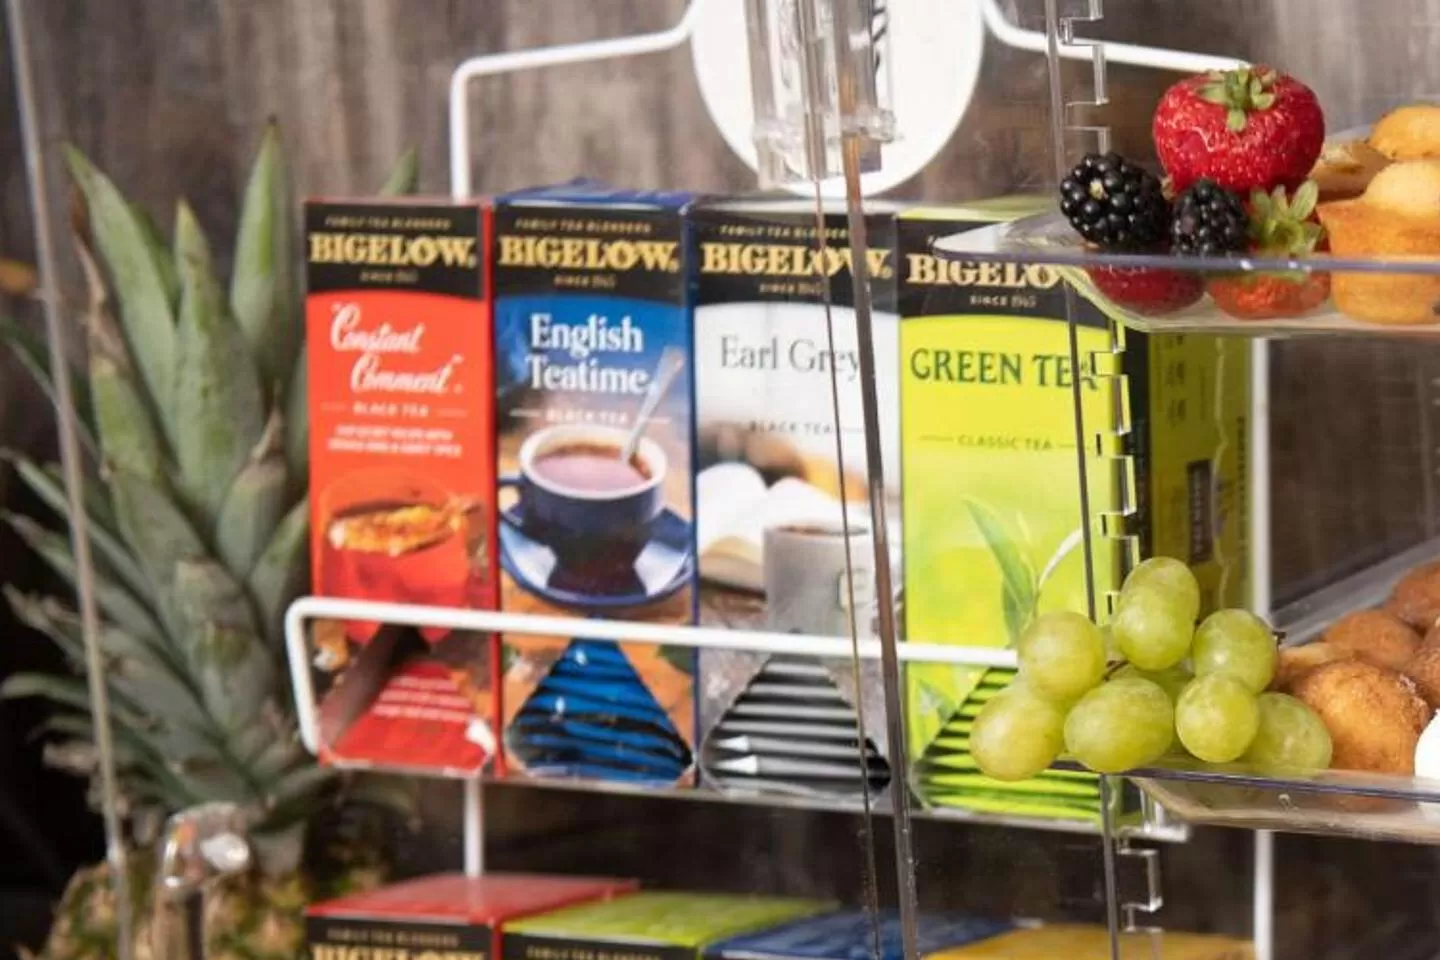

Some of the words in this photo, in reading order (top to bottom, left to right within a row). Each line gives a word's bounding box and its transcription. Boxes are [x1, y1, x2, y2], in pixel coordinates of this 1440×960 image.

[308, 231, 477, 268] BIGELOW
[497, 235, 681, 272] BIGELOW
[906, 253, 1064, 289] BIGELO
[530, 312, 644, 358] English
[721, 335, 777, 370] Earl
[789, 338, 859, 382] Grey
[910, 347, 1022, 385] GREEN
[803, 422, 831, 435] TEA
[958, 434, 1018, 450] CLASSIC
[1025, 437, 1052, 451] TEA
